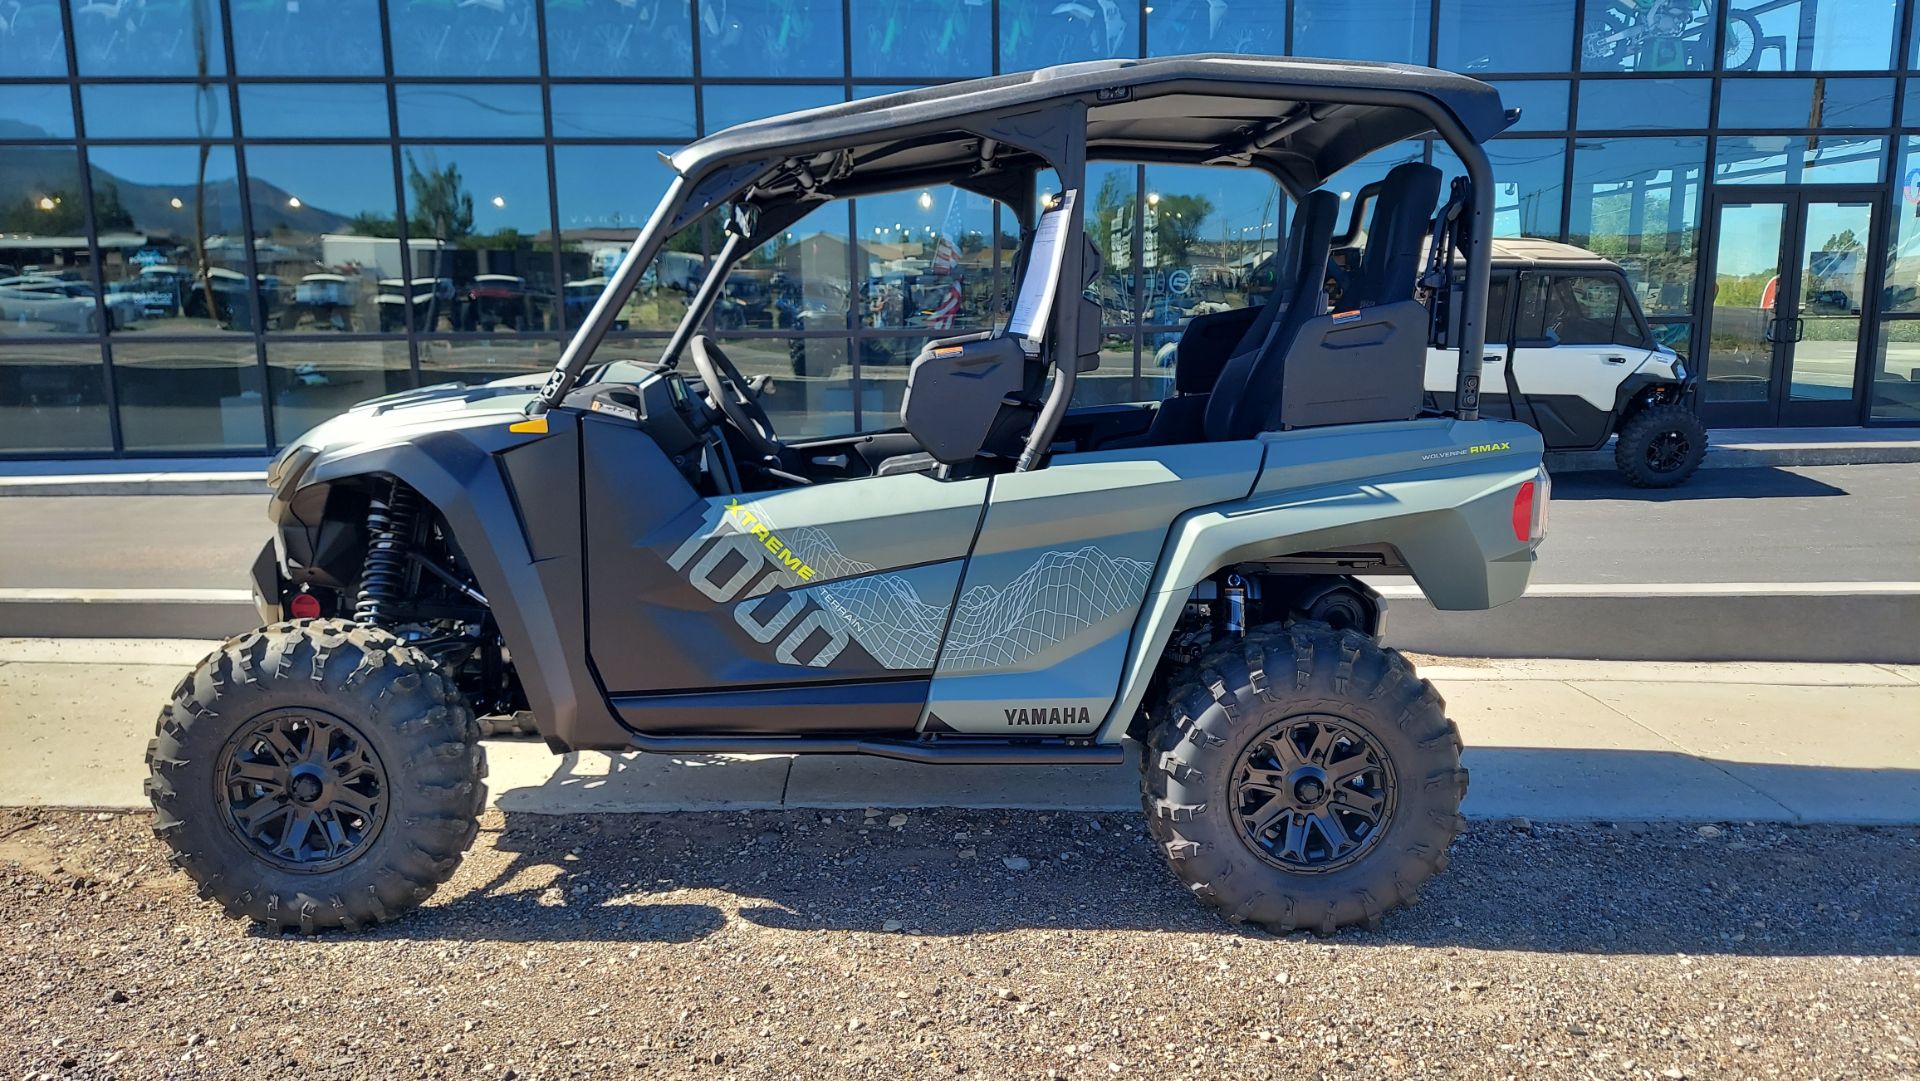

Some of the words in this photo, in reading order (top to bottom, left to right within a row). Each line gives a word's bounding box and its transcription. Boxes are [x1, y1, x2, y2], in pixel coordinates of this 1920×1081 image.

[1421, 449, 1468, 461] WOLVERINE
[1470, 442, 1510, 454] RMAX
[724, 498, 815, 581] XTREME
[666, 512, 849, 668] 1000
[820, 587, 864, 632] TERRAIN
[1004, 707, 1090, 726] YAMAHA
